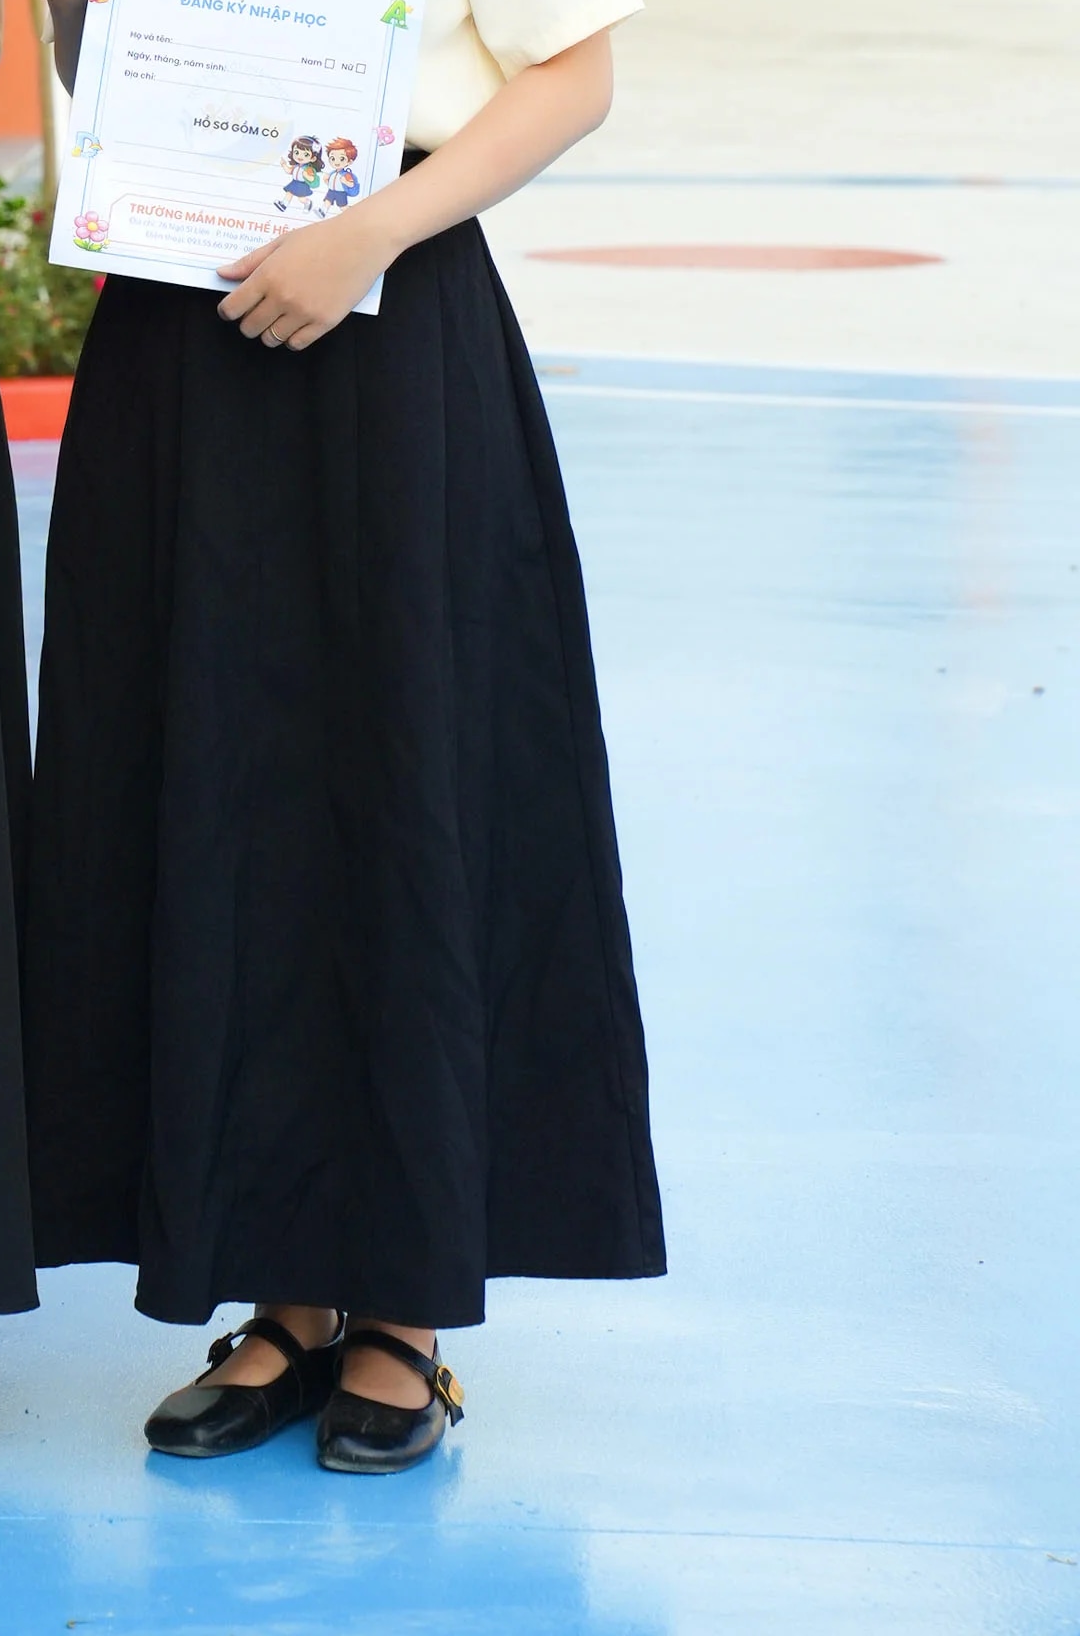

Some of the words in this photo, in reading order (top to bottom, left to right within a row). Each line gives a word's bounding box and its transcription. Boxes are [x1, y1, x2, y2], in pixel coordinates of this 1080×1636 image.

[227, 0, 247, 14] KÝ
[249, 5, 291, 23] NHẬP
[294, 11, 327, 28] HỌC
[130, 31, 142, 40] Họ
[301, 57, 323, 66] Nam
[124, 69, 139, 79] Địa
[213, 121, 229, 131] SƠ
[261, 126, 279, 138] CÓ
[130, 203, 183, 220] TRƯỜNG
[217, 216, 245, 229] NON
[247, 219, 272, 233] THẾ
